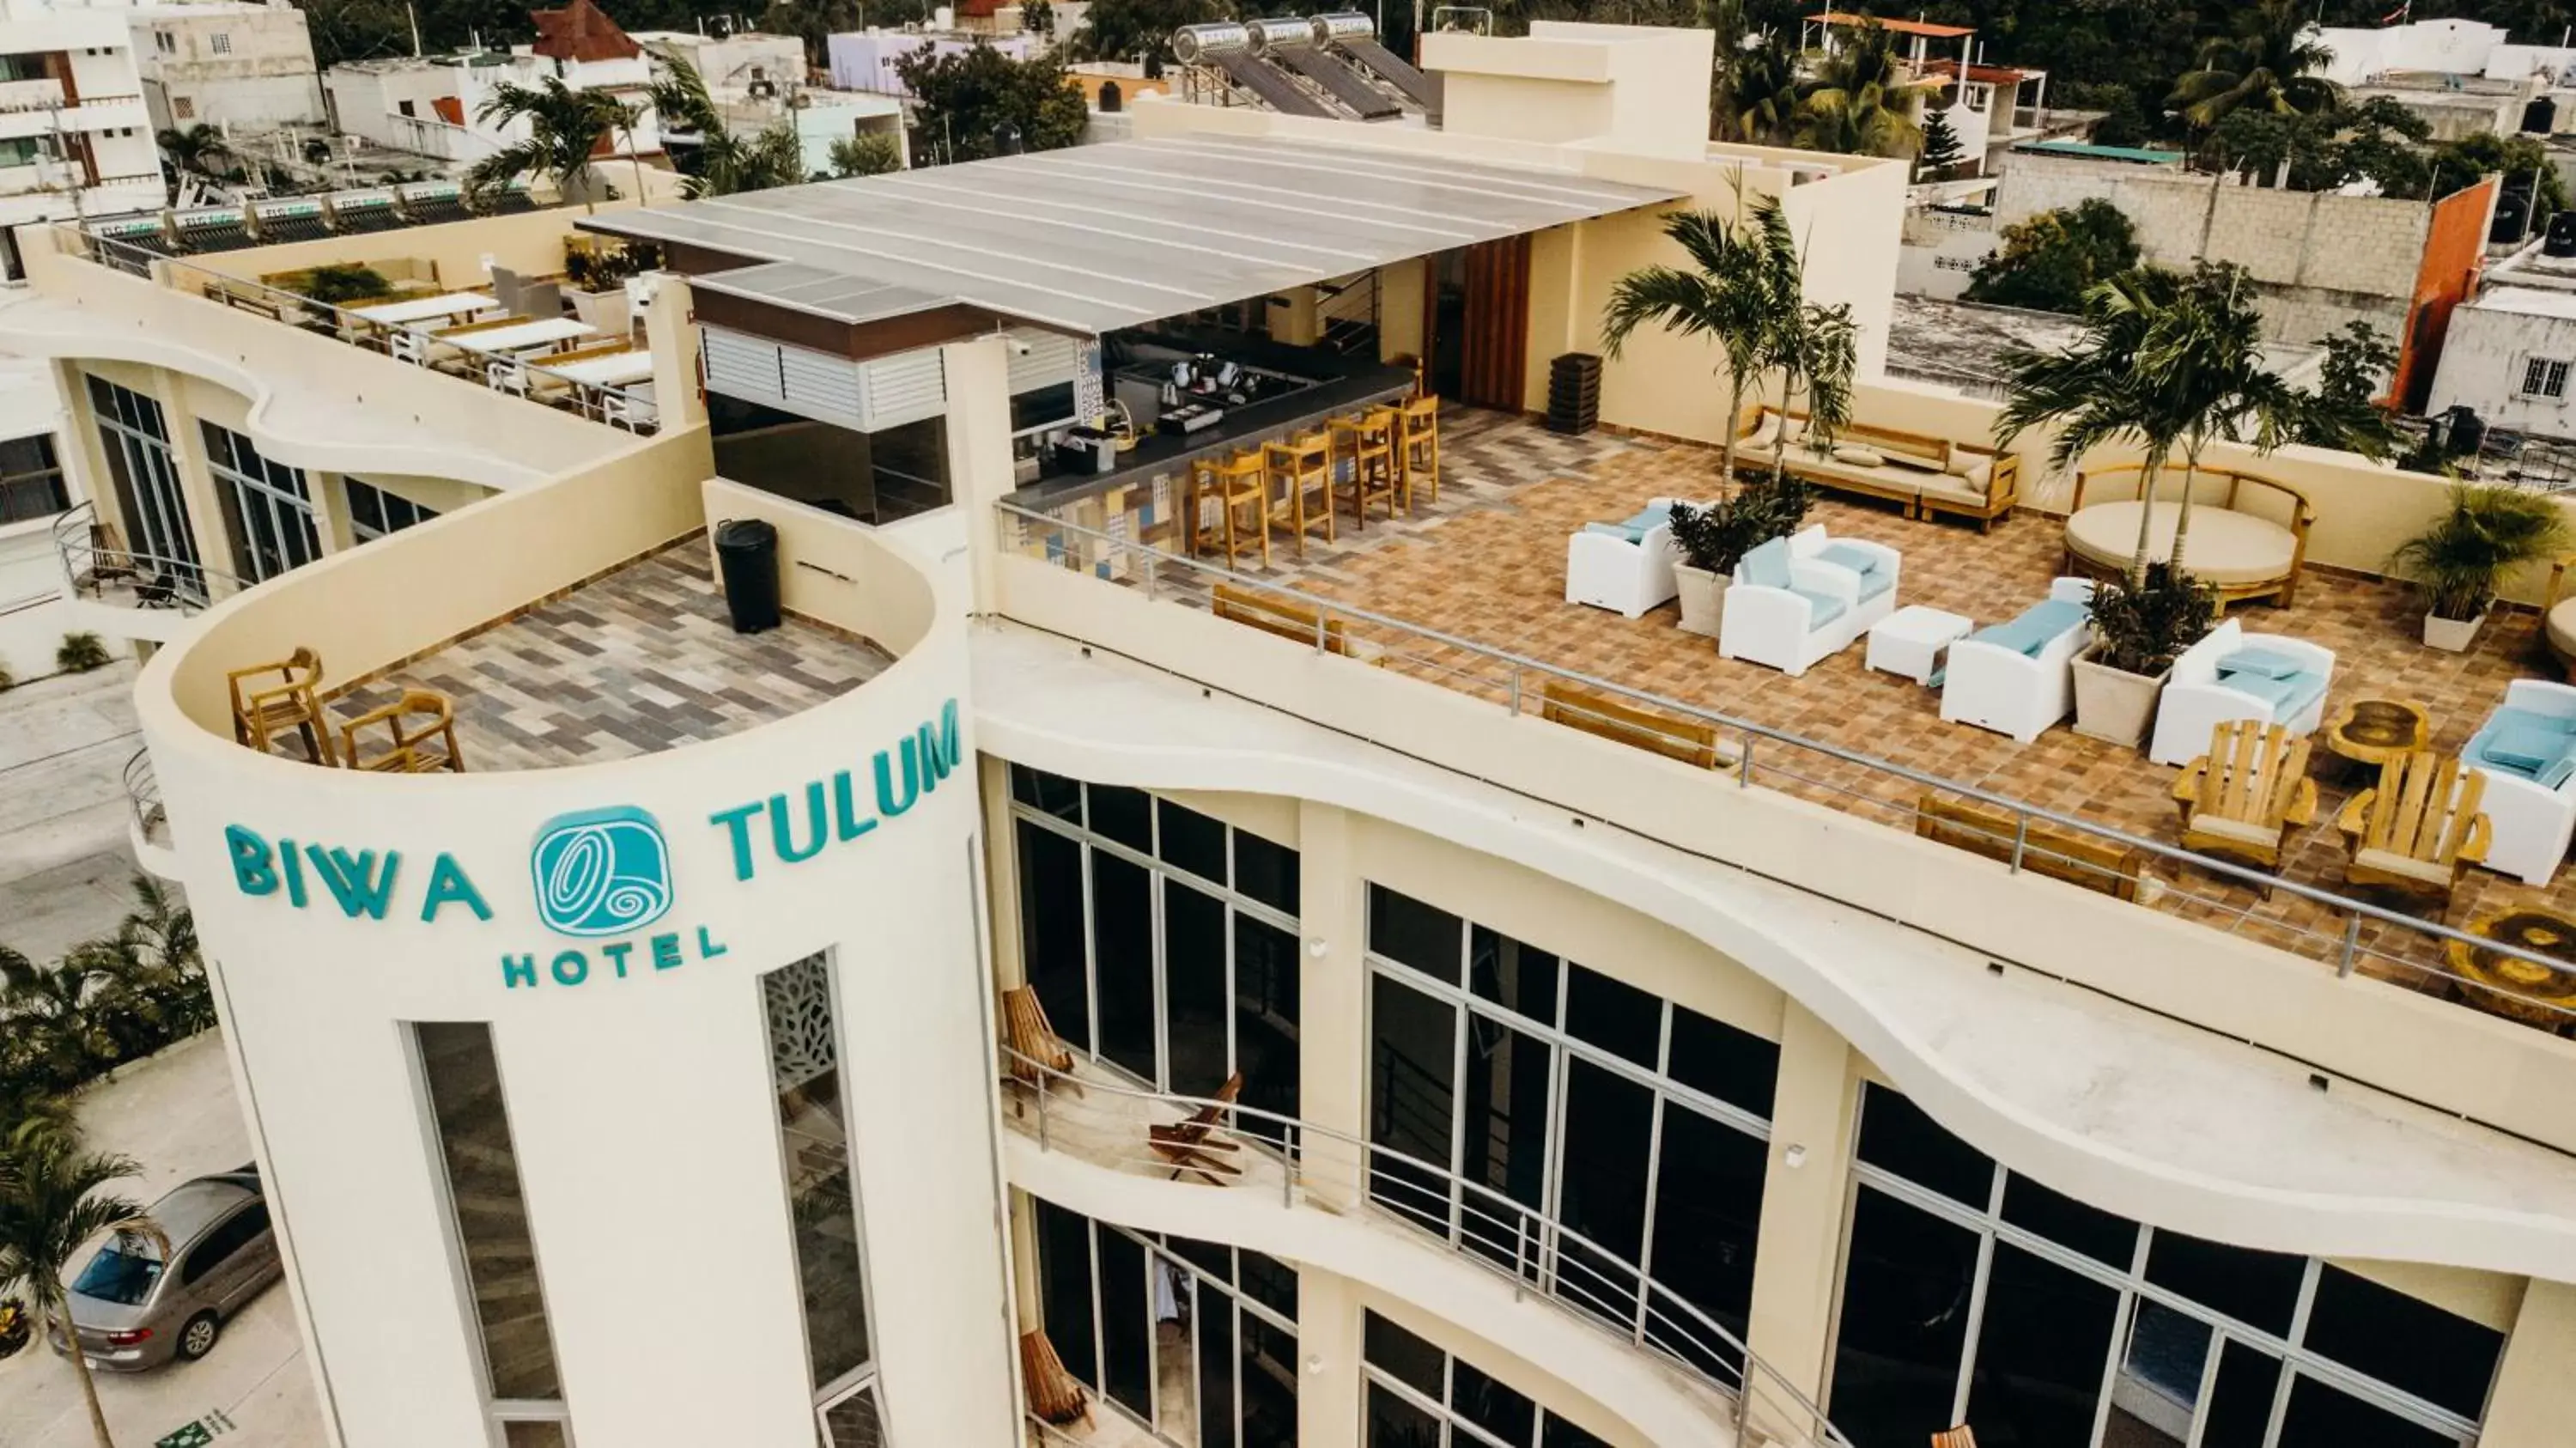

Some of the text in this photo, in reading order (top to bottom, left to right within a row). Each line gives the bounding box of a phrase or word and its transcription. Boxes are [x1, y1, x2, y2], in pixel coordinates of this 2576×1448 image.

[225, 697, 962, 922] BIWA TULUM
[501, 925, 727, 988] HOTEL
